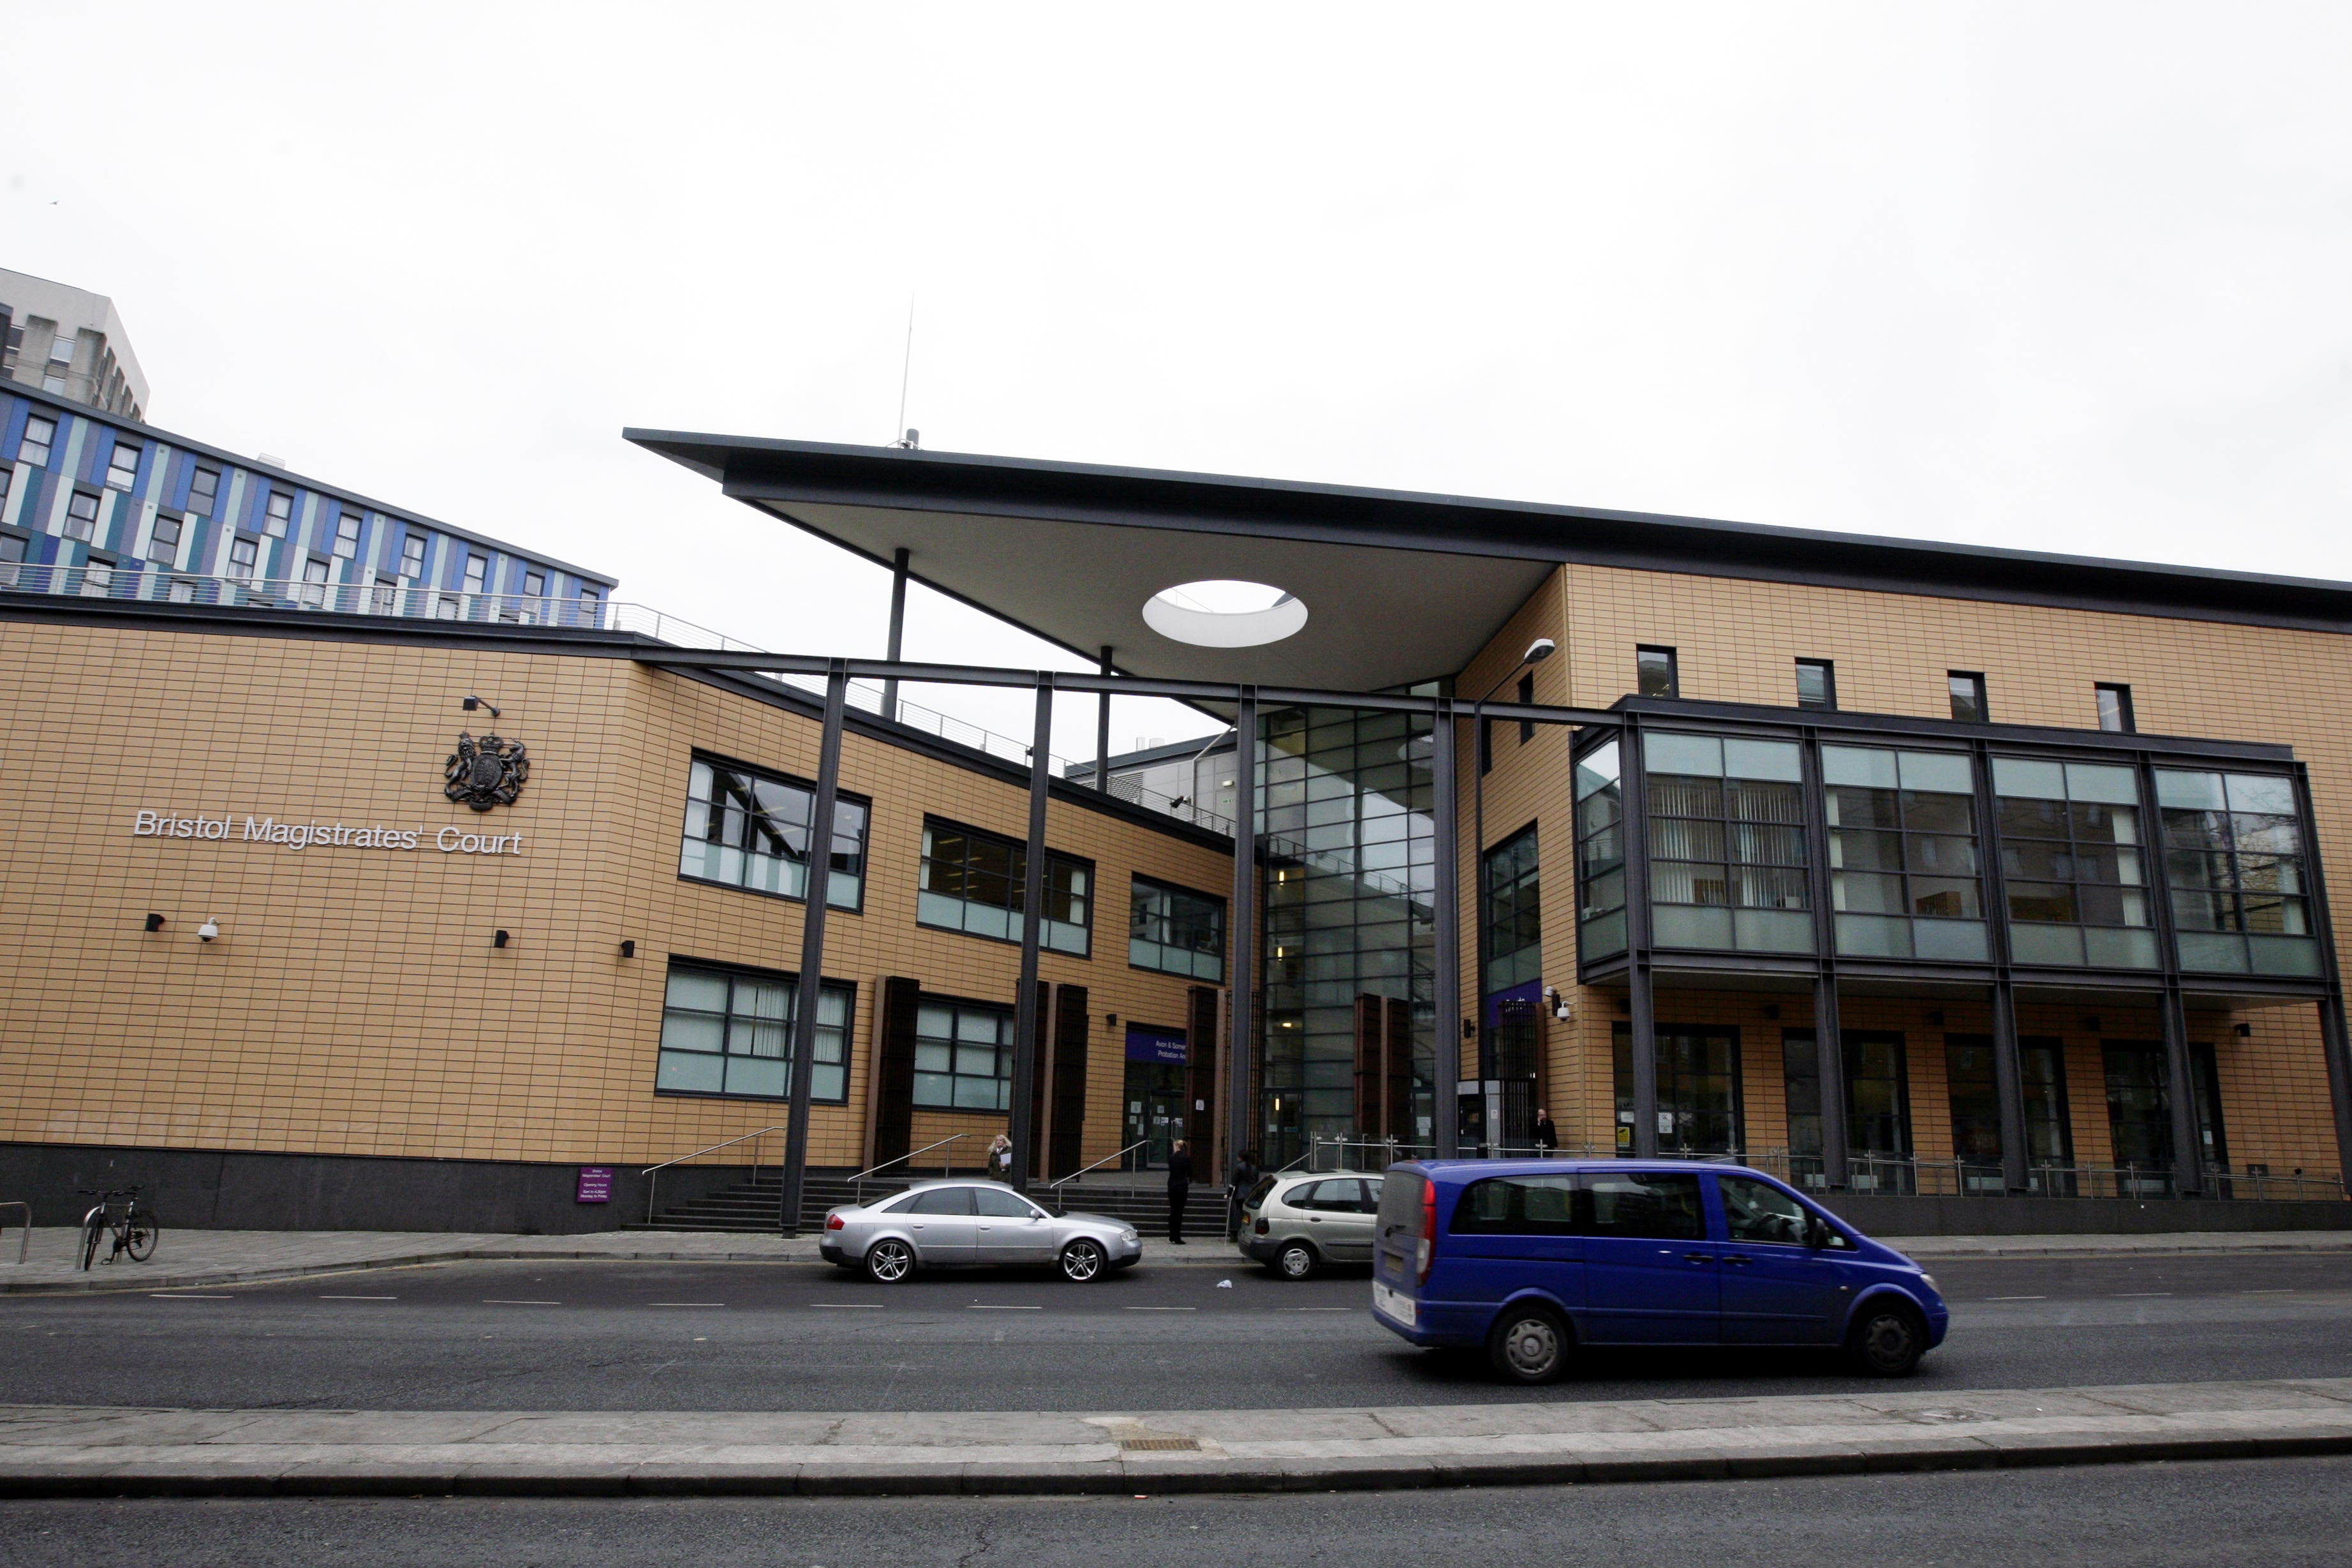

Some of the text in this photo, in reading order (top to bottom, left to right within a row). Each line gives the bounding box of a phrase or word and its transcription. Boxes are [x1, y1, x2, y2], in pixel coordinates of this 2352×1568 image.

[134, 810, 522, 855] Bristol Magistrates' Court
